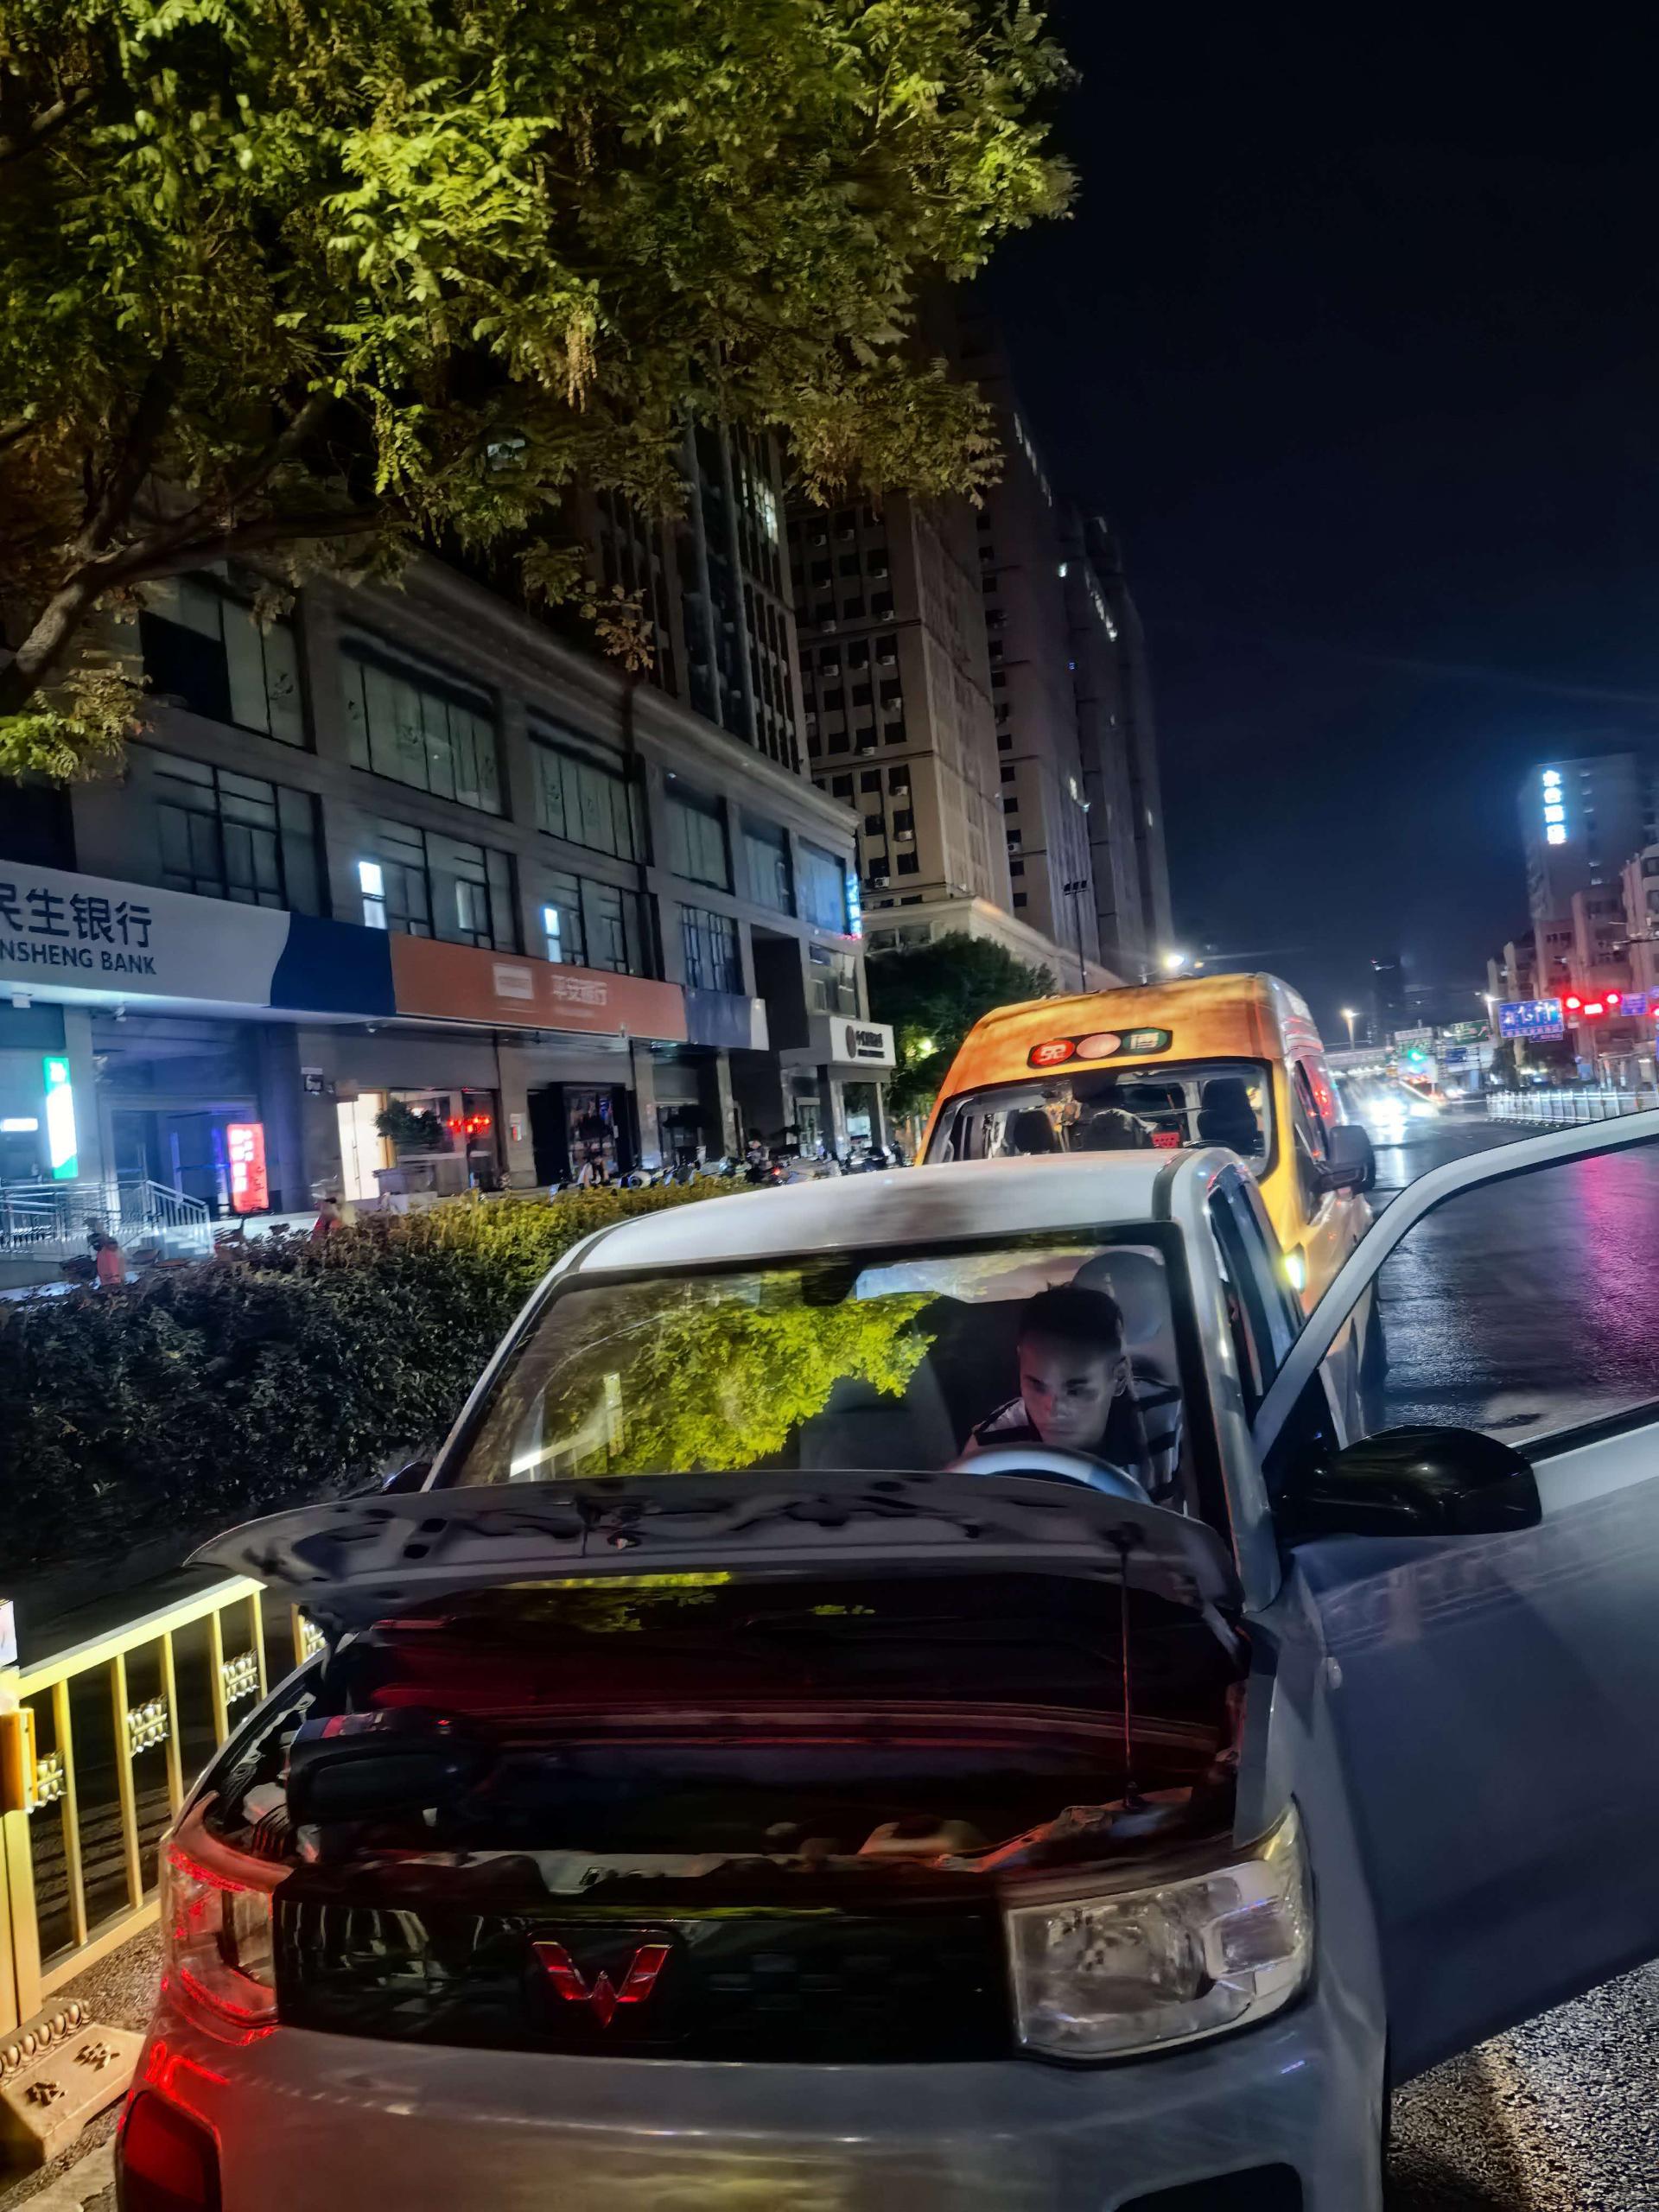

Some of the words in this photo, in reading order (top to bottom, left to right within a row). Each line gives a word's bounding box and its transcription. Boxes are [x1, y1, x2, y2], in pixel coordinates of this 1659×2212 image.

[0, 882, 152, 948] 民生银行
[101, 950, 156, 975] BANK
